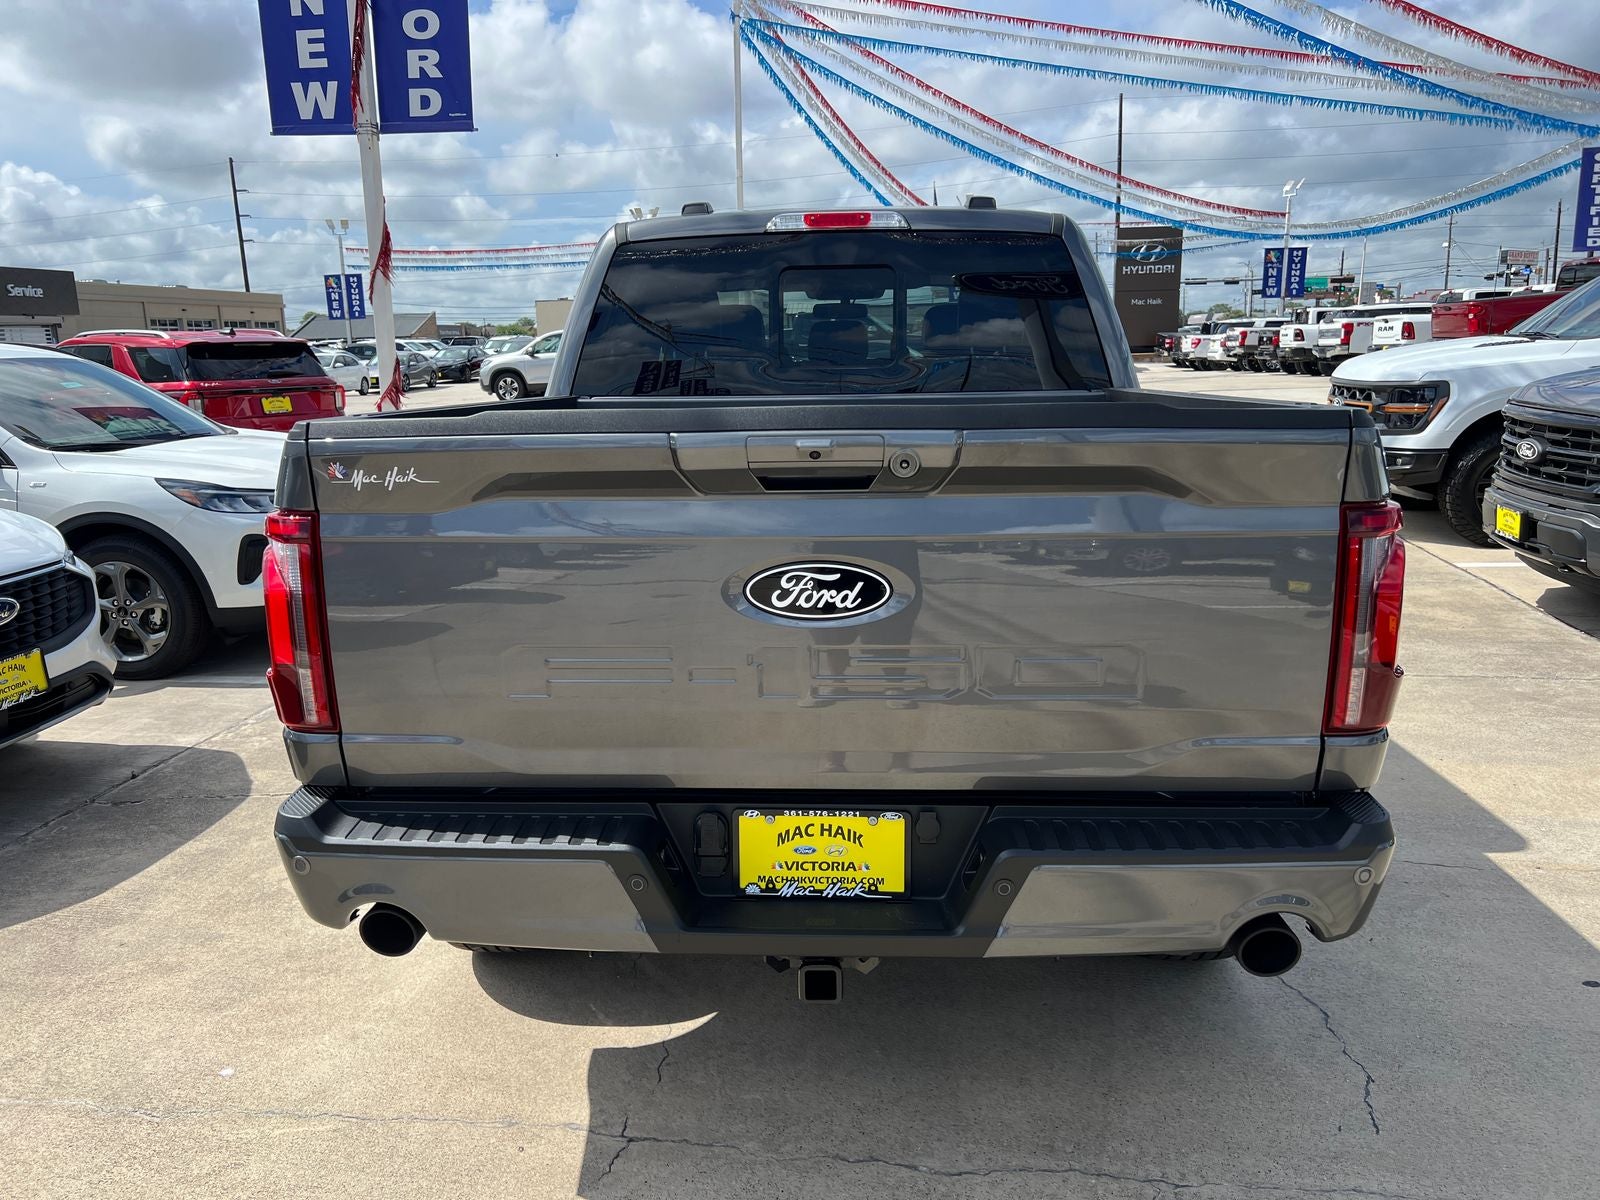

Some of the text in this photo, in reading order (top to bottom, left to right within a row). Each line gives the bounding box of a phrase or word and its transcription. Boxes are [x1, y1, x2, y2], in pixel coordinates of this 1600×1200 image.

[402, 8, 443, 117] ORD
[1122, 264, 1175, 275] HYUNDAI
[1266, 268, 1277, 296] NEW
[1290, 250, 1302, 295] HYUNDAI
[6, 283, 44, 298] Service
[349, 276, 361, 317] HYUNDAI
[1146, 297, 1163, 305] Haik
[331, 292, 342, 318] NEW
[350, 466, 437, 491] Mac Haik
[771, 571, 864, 609] Ford
[7, 663, 26, 673] HAIK
[500, 643, 1148, 701] F-150
[783, 810, 860, 818] 361-576-1221
[776, 823, 864, 848] MAC HAIK
[796, 846, 814, 855] Ford
[784, 861, 857, 872] VICTORIA
[776, 881, 886, 898] Mac Haik
